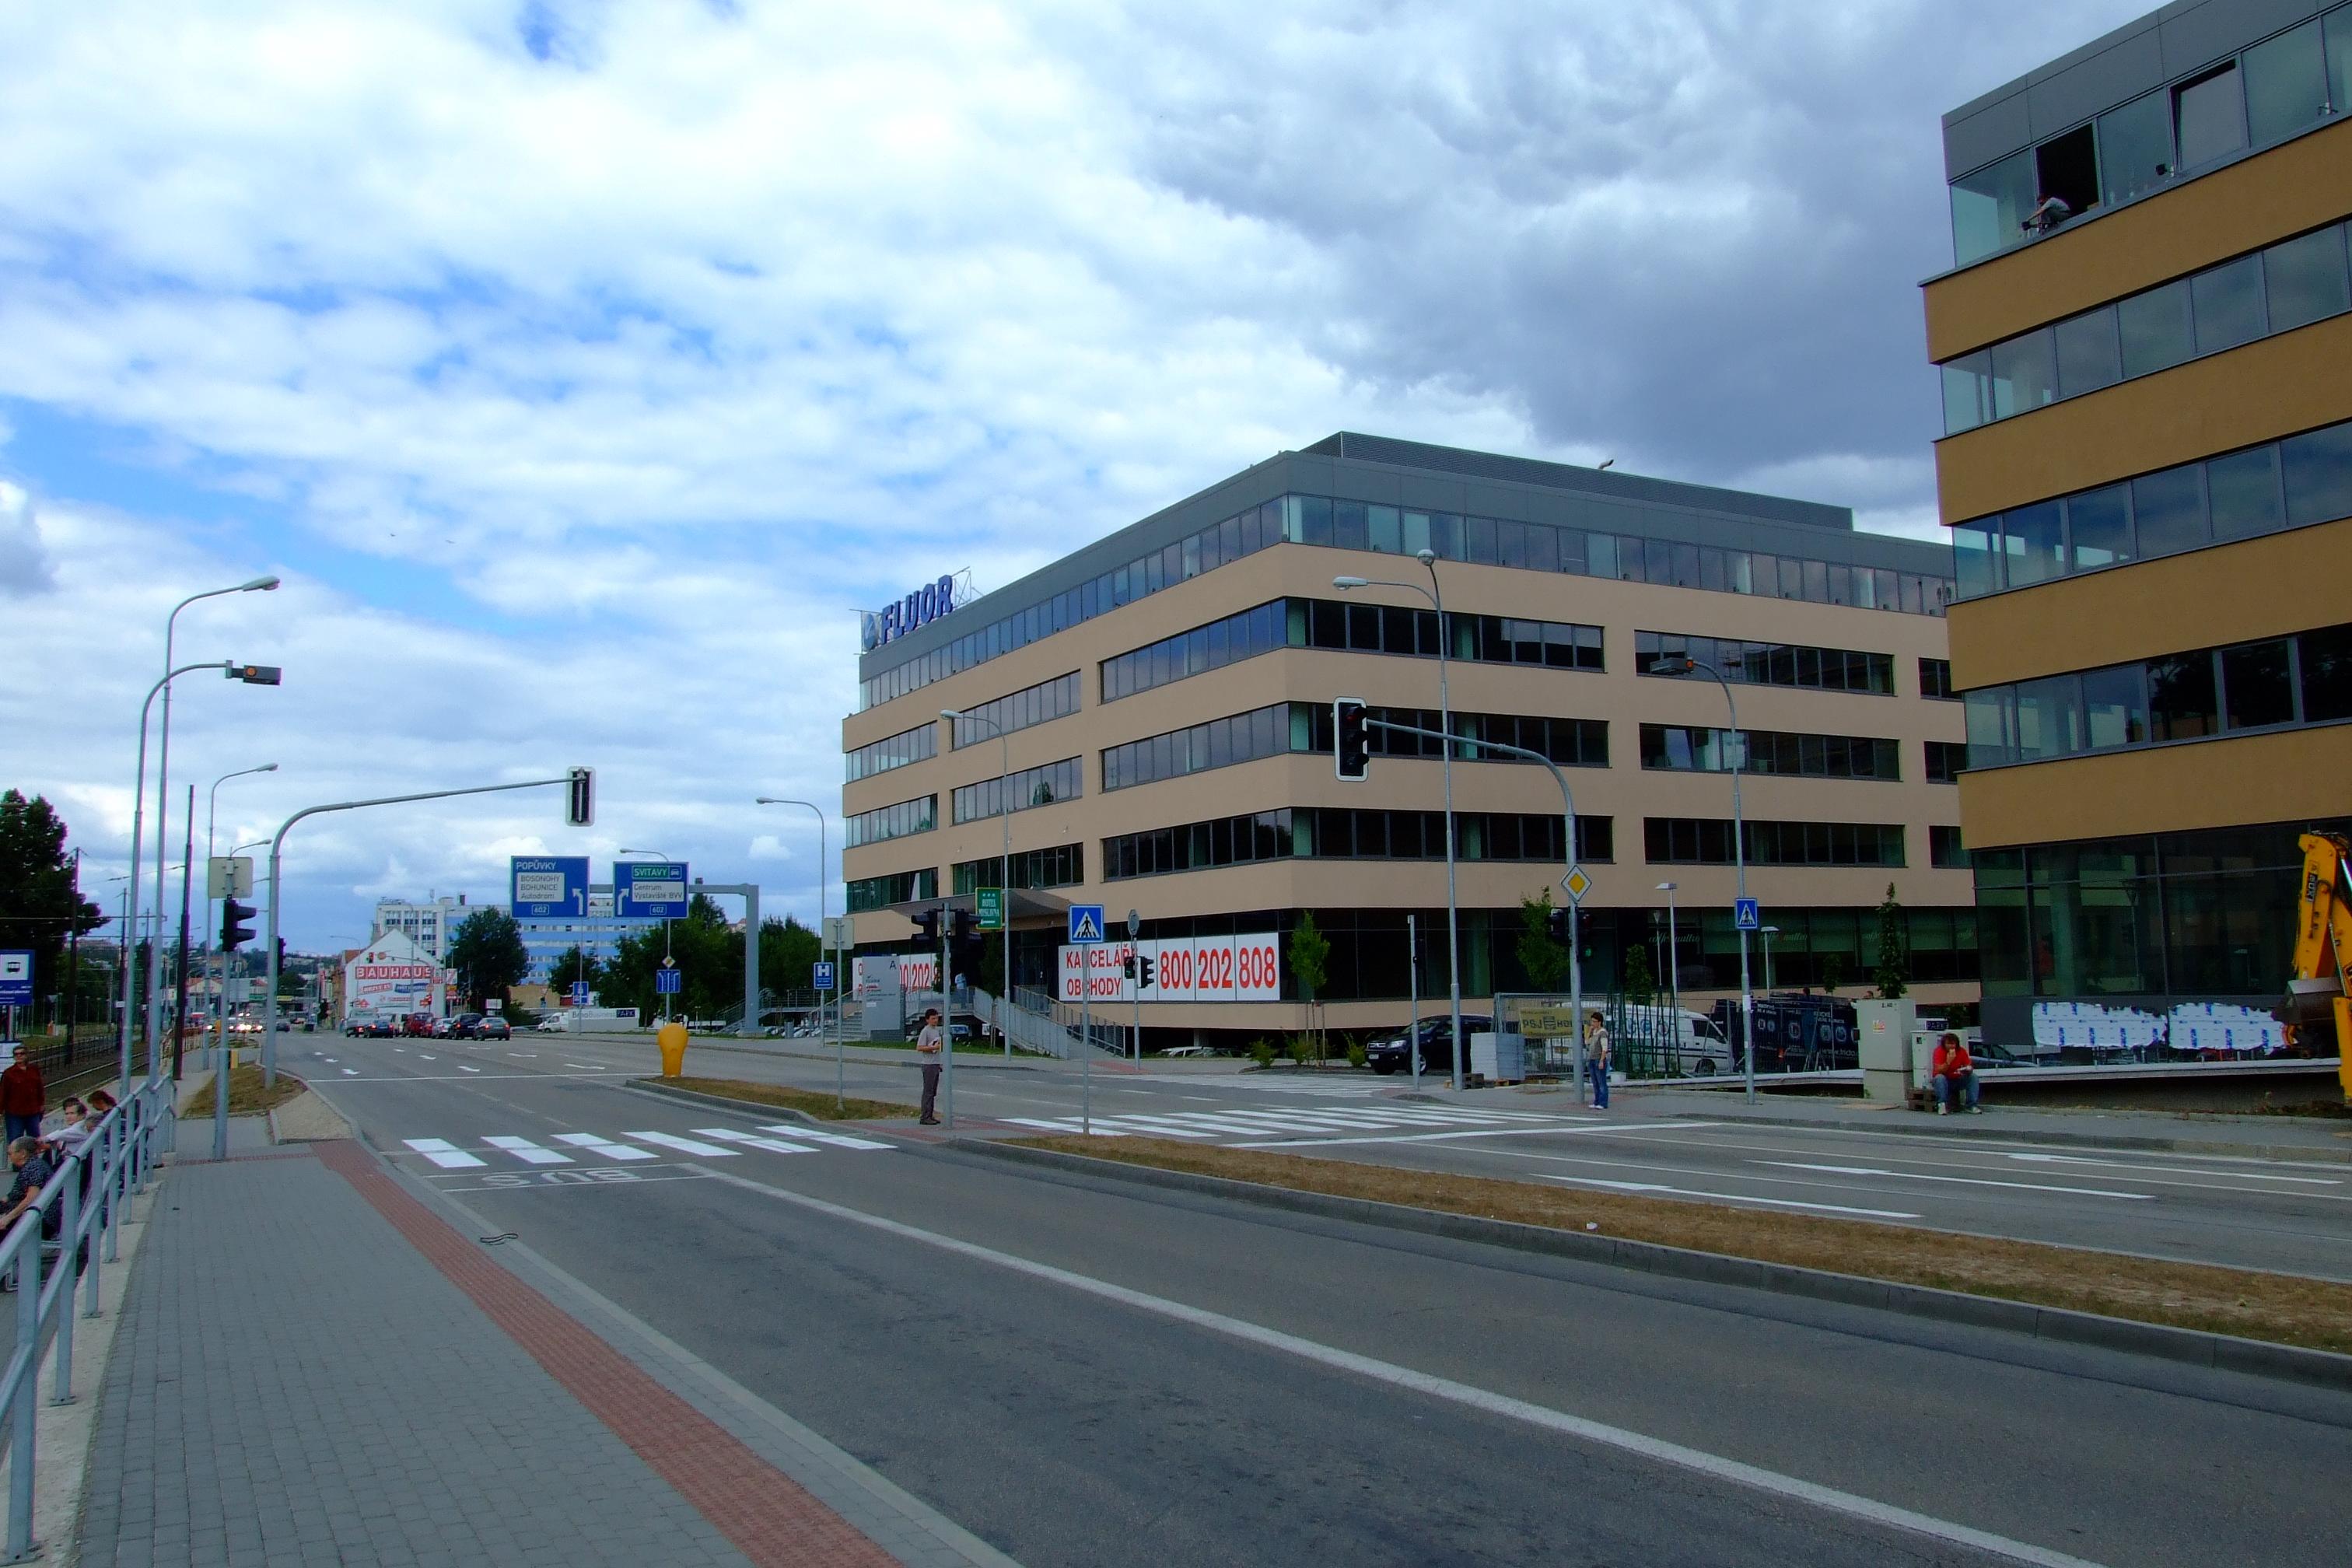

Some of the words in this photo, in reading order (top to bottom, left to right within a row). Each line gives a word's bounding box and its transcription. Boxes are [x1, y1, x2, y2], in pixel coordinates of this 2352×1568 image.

[880, 575, 954, 644] FLUOR
[516, 859, 557, 870] POPŮVKY
[634, 867, 667, 877] SVITAVY
[1066, 943, 1136, 969] KACELÁŘ
[357, 966, 432, 978] BAUHAUS
[817, 964, 830, 977] H
[1160, 950, 1192, 990] 800
[1198, 947, 1234, 989] 202
[1238, 946, 1276, 989] 808
[912, 963, 931, 992] 202
[1067, 977, 1122, 996] OBHODY
[1522, 1018, 1543, 1029] PSJ
[481, 1169, 642, 1187] BUS
